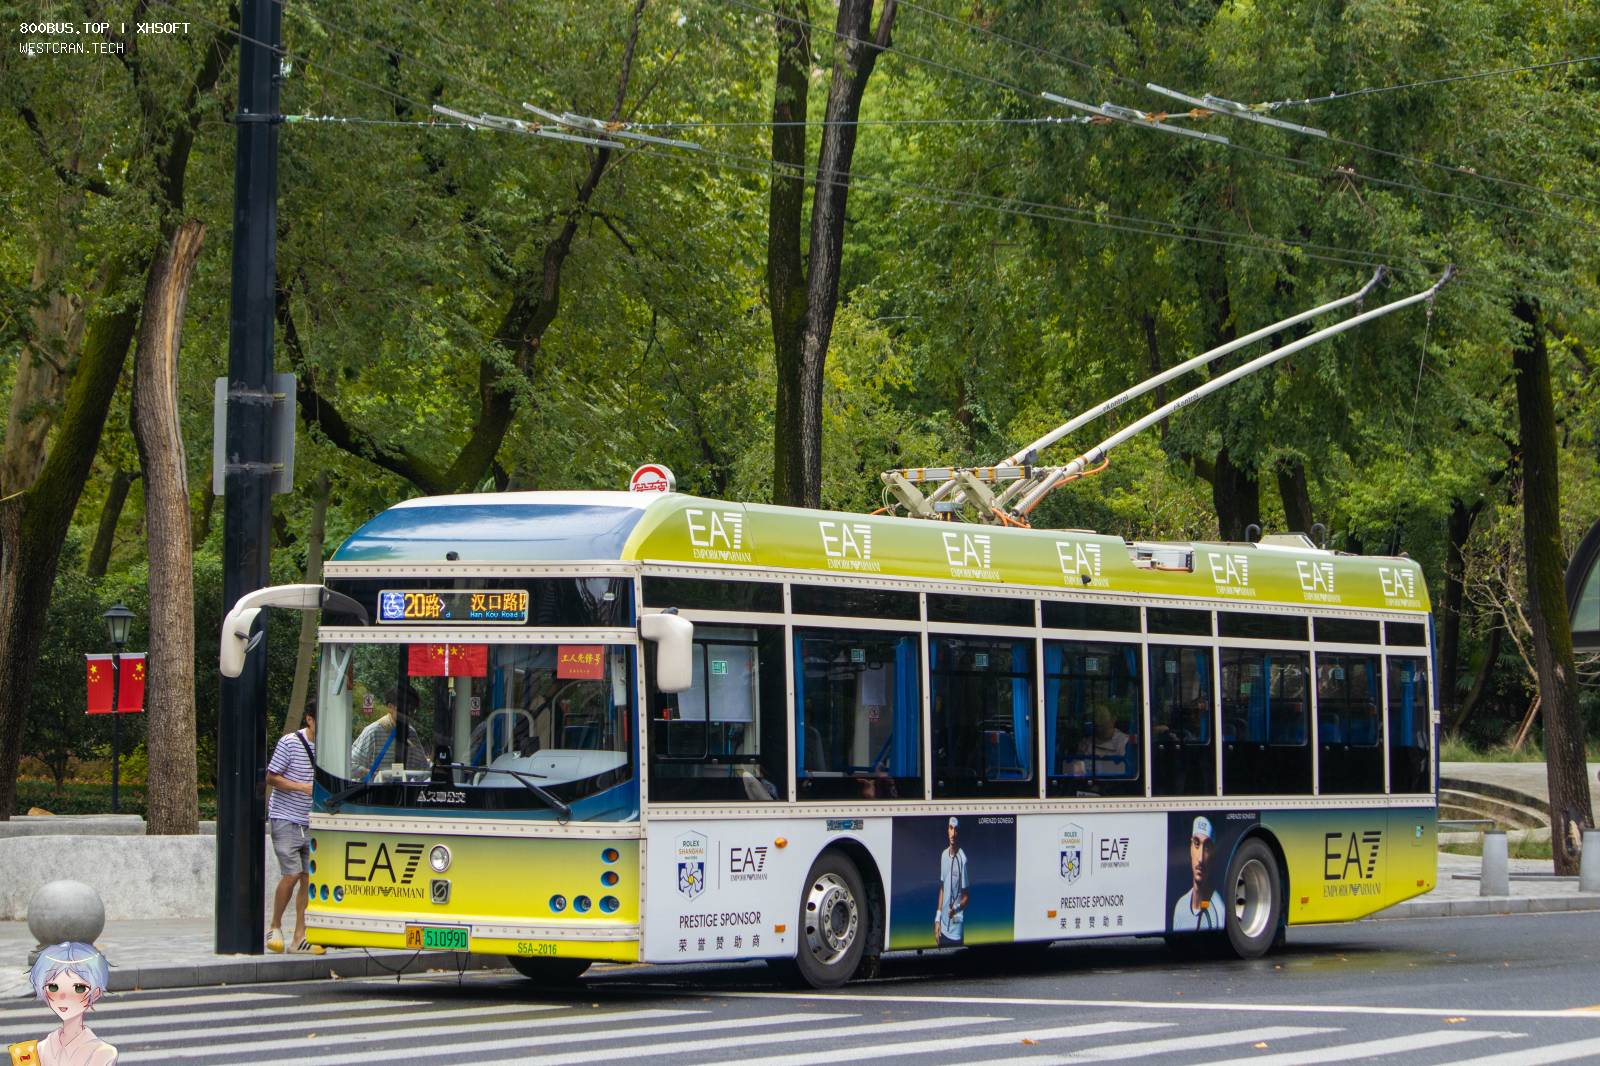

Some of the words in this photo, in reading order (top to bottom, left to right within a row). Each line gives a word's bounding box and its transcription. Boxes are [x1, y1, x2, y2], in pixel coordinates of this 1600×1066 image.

[686, 509, 743, 549] EA7
[819, 521, 872, 560] EA7
[942, 532, 991, 569] EA7
[1056, 541, 1101, 577] EA7
[1208, 552, 1248, 586] EA7
[1296, 560, 1334, 593] EA7
[1378, 567, 1414, 598] EA7
[404, 593, 440, 618] 20路
[345, 841, 424, 885] EA7
[731, 846, 768, 873] EA7
[1100, 838, 1130, 861] EA7
[1324, 831, 1382, 880] EA7
[344, 884, 380, 897] EMPORIO
[391, 886, 425, 899] ARMANI
[1060, 896, 1091, 908] PRESTIGE
[1092, 894, 1124, 908] SPONSOR
[679, 914, 718, 928] PRESTIGE
[720, 911, 761, 927] SPONSOR
[517, 942, 557, 954] S5A-2016
[678, 934, 761, 953] 荣誉赞助商
